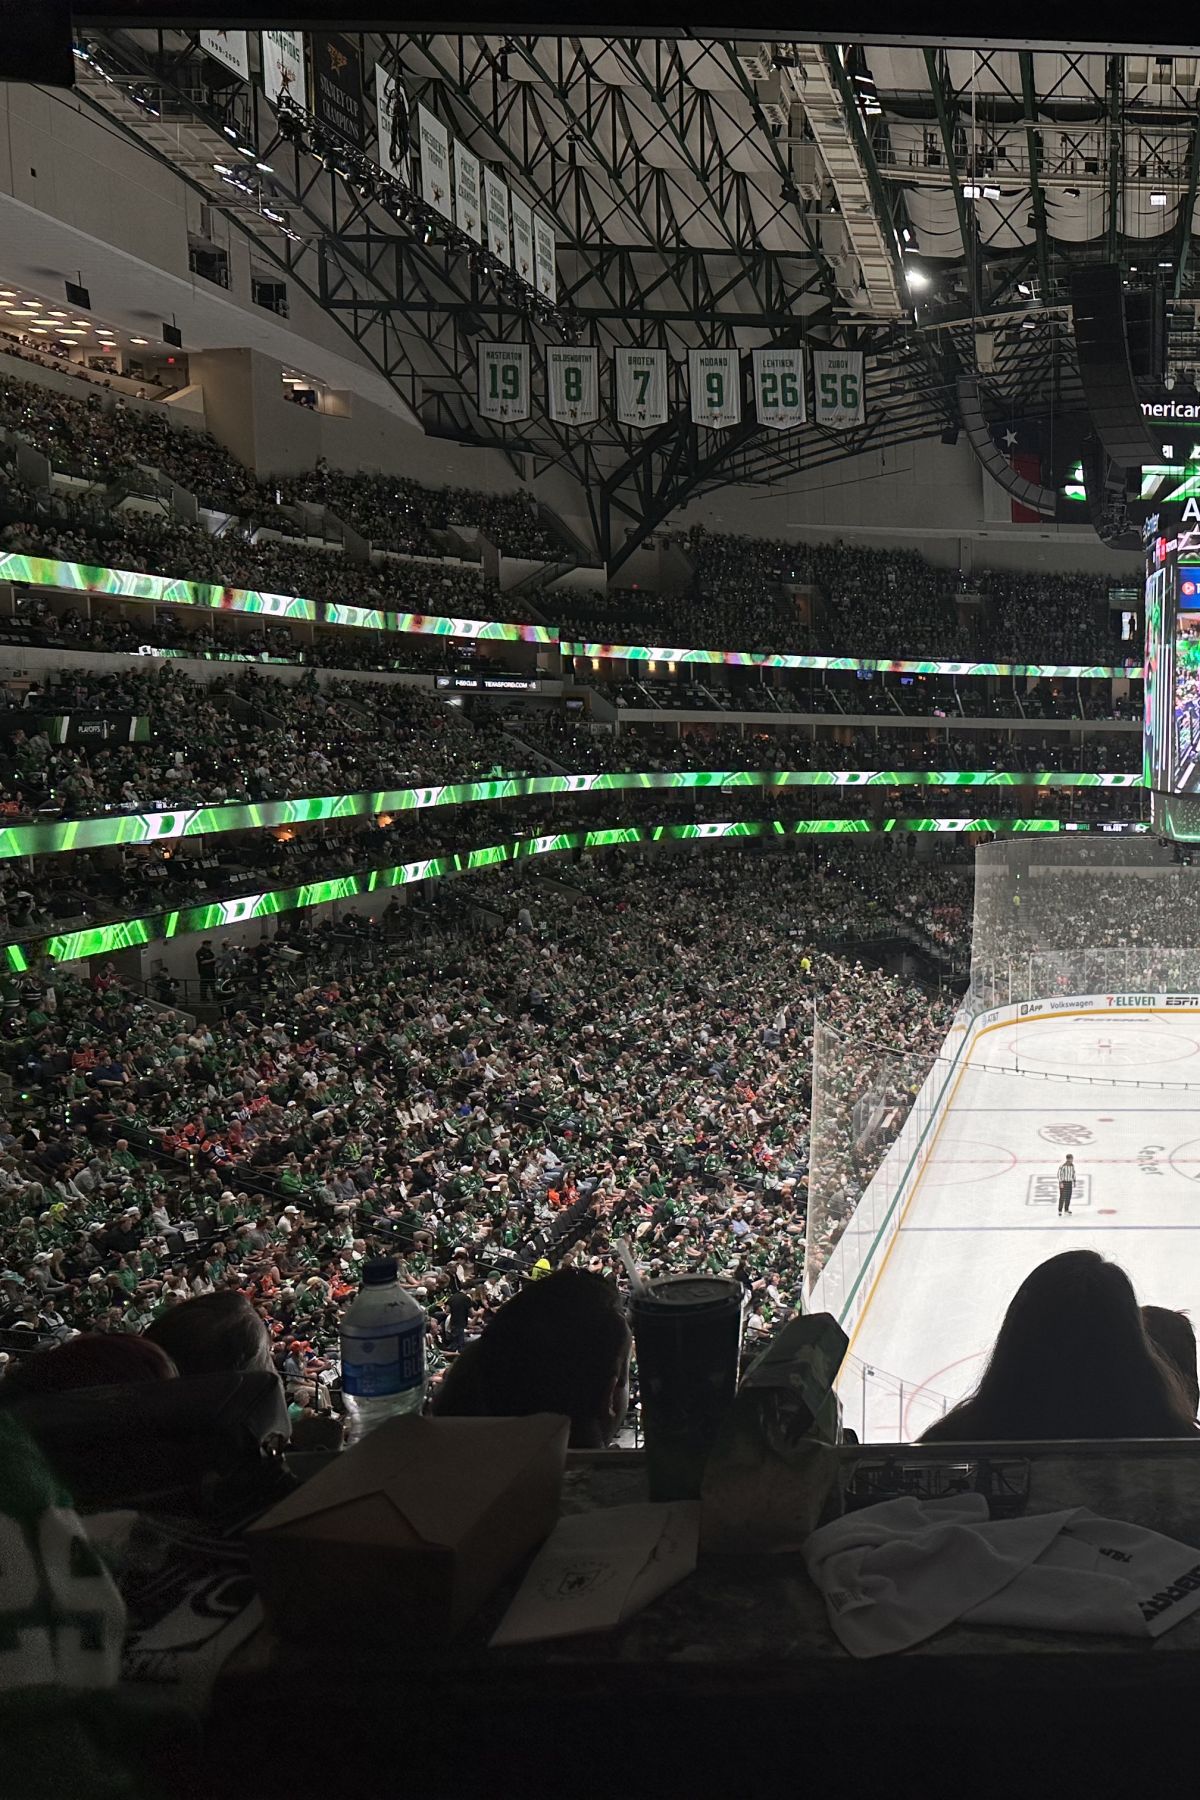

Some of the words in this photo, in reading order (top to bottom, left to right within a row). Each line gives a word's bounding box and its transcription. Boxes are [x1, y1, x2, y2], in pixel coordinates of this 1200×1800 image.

[628, 357, 656, 366] BROTEN
[700, 357, 728, 367] MODANO
[828, 360, 849, 369] ZUBOV
[489, 363, 520, 400] 19
[564, 367, 582, 402] 8
[633, 370, 651, 405] 7
[706, 372, 724, 408] 9
[761, 372, 799, 408] 26
[820, 373, 858, 409] 56
[484, 680, 528, 688] TEXASFORD.COM
[1050, 999, 1094, 1010] Volkswagen
[1166, 996, 1198, 1006] ESPN
[1138, 1145, 1166, 1176] Center
[1034, 1176, 1058, 1204] LIGHT
